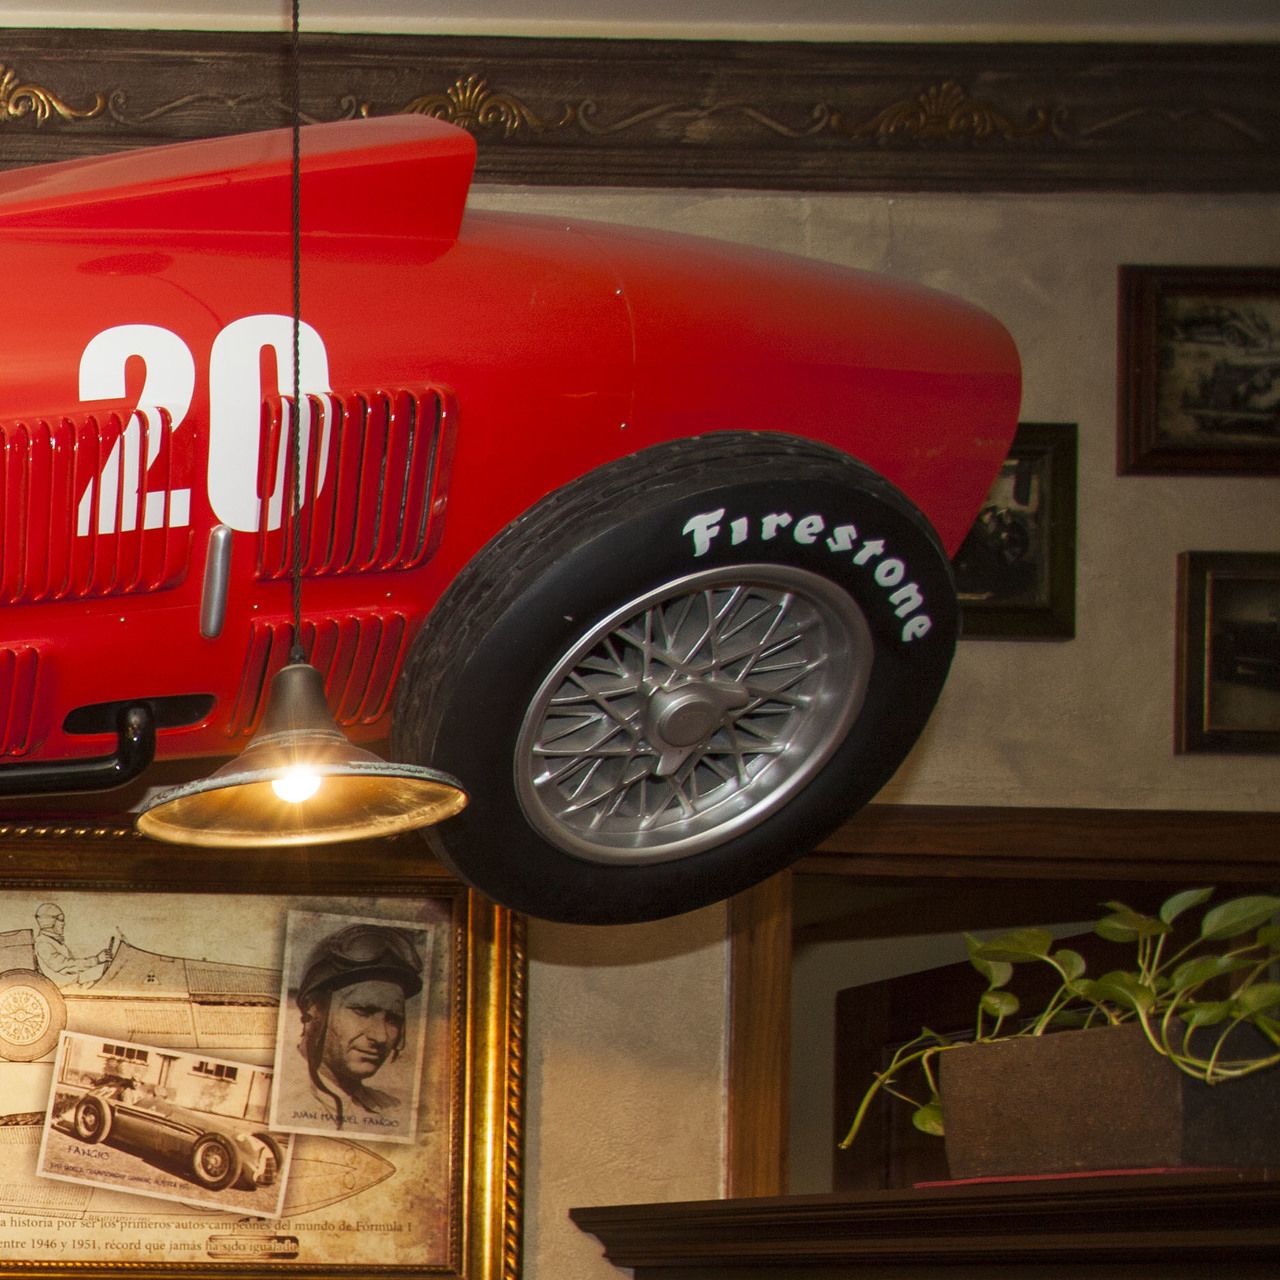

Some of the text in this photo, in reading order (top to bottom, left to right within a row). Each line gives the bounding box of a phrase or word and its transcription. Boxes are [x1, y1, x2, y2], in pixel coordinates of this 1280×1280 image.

[77, 314, 333, 536] 20
[682, 508, 933, 642] Firestone
[291, 1110, 317, 1120] JUAN
[67, 1144, 110, 1160] FANGIO
[10, 1216, 53, 1228] historia
[57, 1220, 77, 1231] por
[81, 1219, 97, 1229] ser
[100, 1217, 116, 1229] los
[120, 1219, 172, 1232] primeros
[175, 1220, 206, 1230] autos
[208, 1220, 271, 1232] campeones
[274, 1219, 291, 1231] del
[295, 1220, 336, 1232] mundo
[339, 1220, 352, 1232] de
[31, 1238, 57, 1249] 1946
[60, 1241, 68, 1252] y
[71, 1239, 101, 1250] 1951,
[104, 1239, 141, 1250] récord
[144, 1241, 166, 1253] que
[169, 1240, 202, 1252] jamás
[205, 1240, 219, 1251] ha
[223, 1240, 246, 1251] sido
